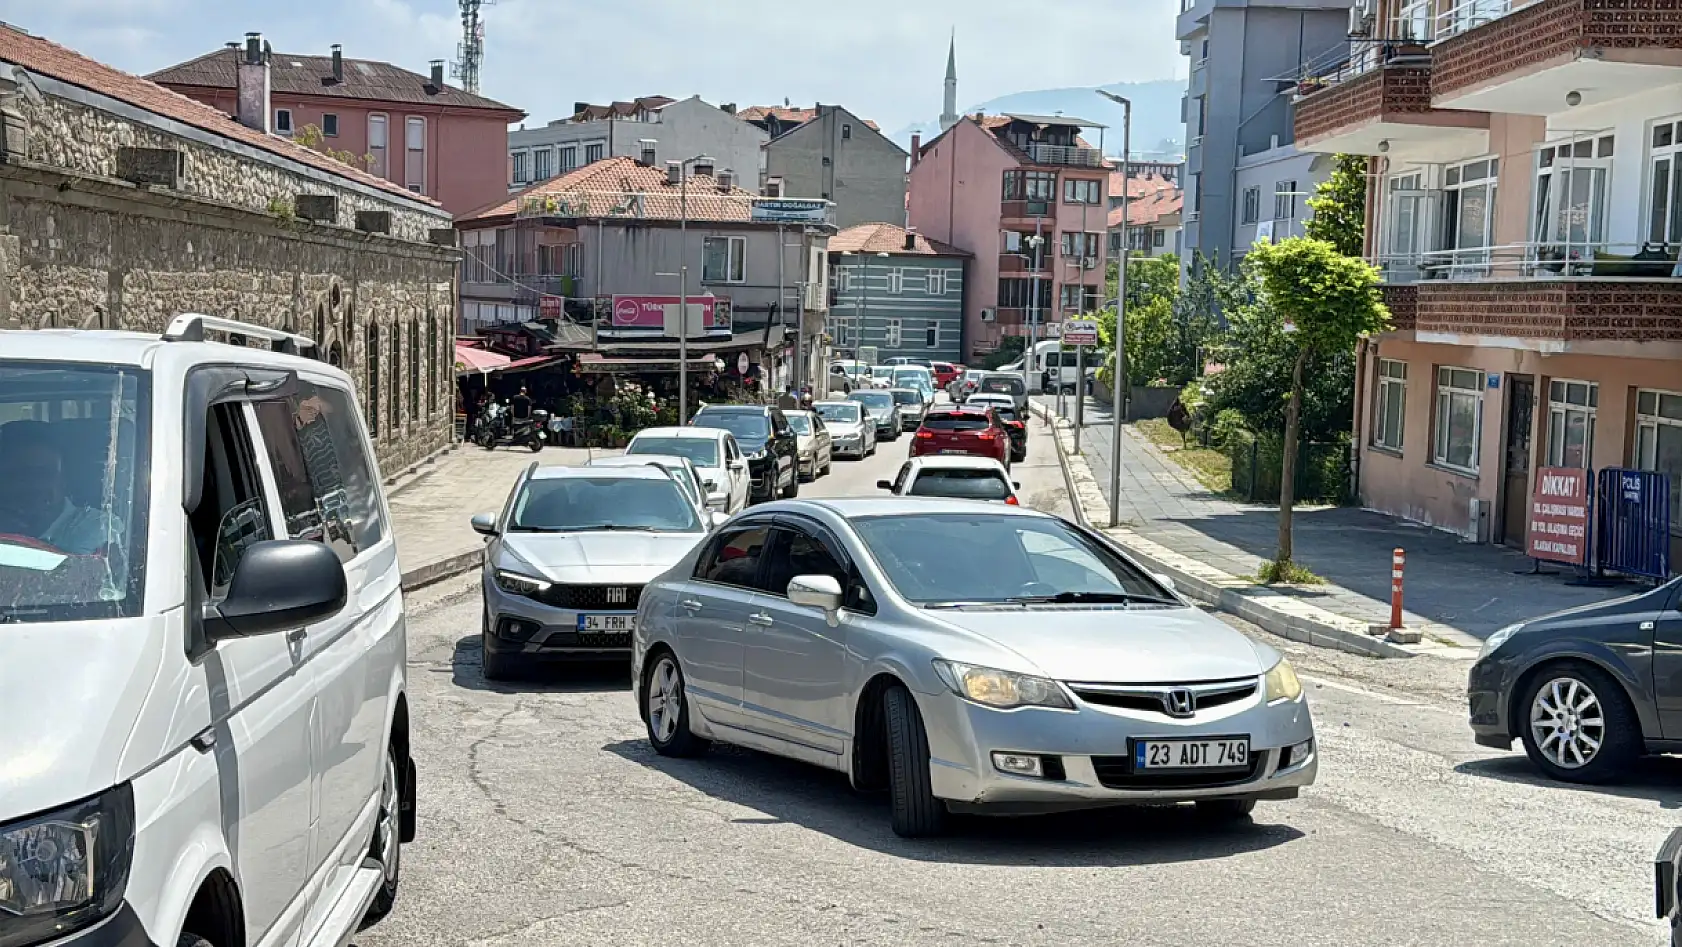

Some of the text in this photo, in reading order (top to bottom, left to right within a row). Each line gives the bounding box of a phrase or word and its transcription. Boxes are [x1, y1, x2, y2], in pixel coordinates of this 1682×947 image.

[607, 587, 627, 603] FIAT
[586, 616, 599, 628] 34
[604, 616, 625, 629] FRH
[1150, 744, 1170, 765] 23
[1180, 743, 1209, 765] ADT
[1218, 742, 1245, 764] 749
